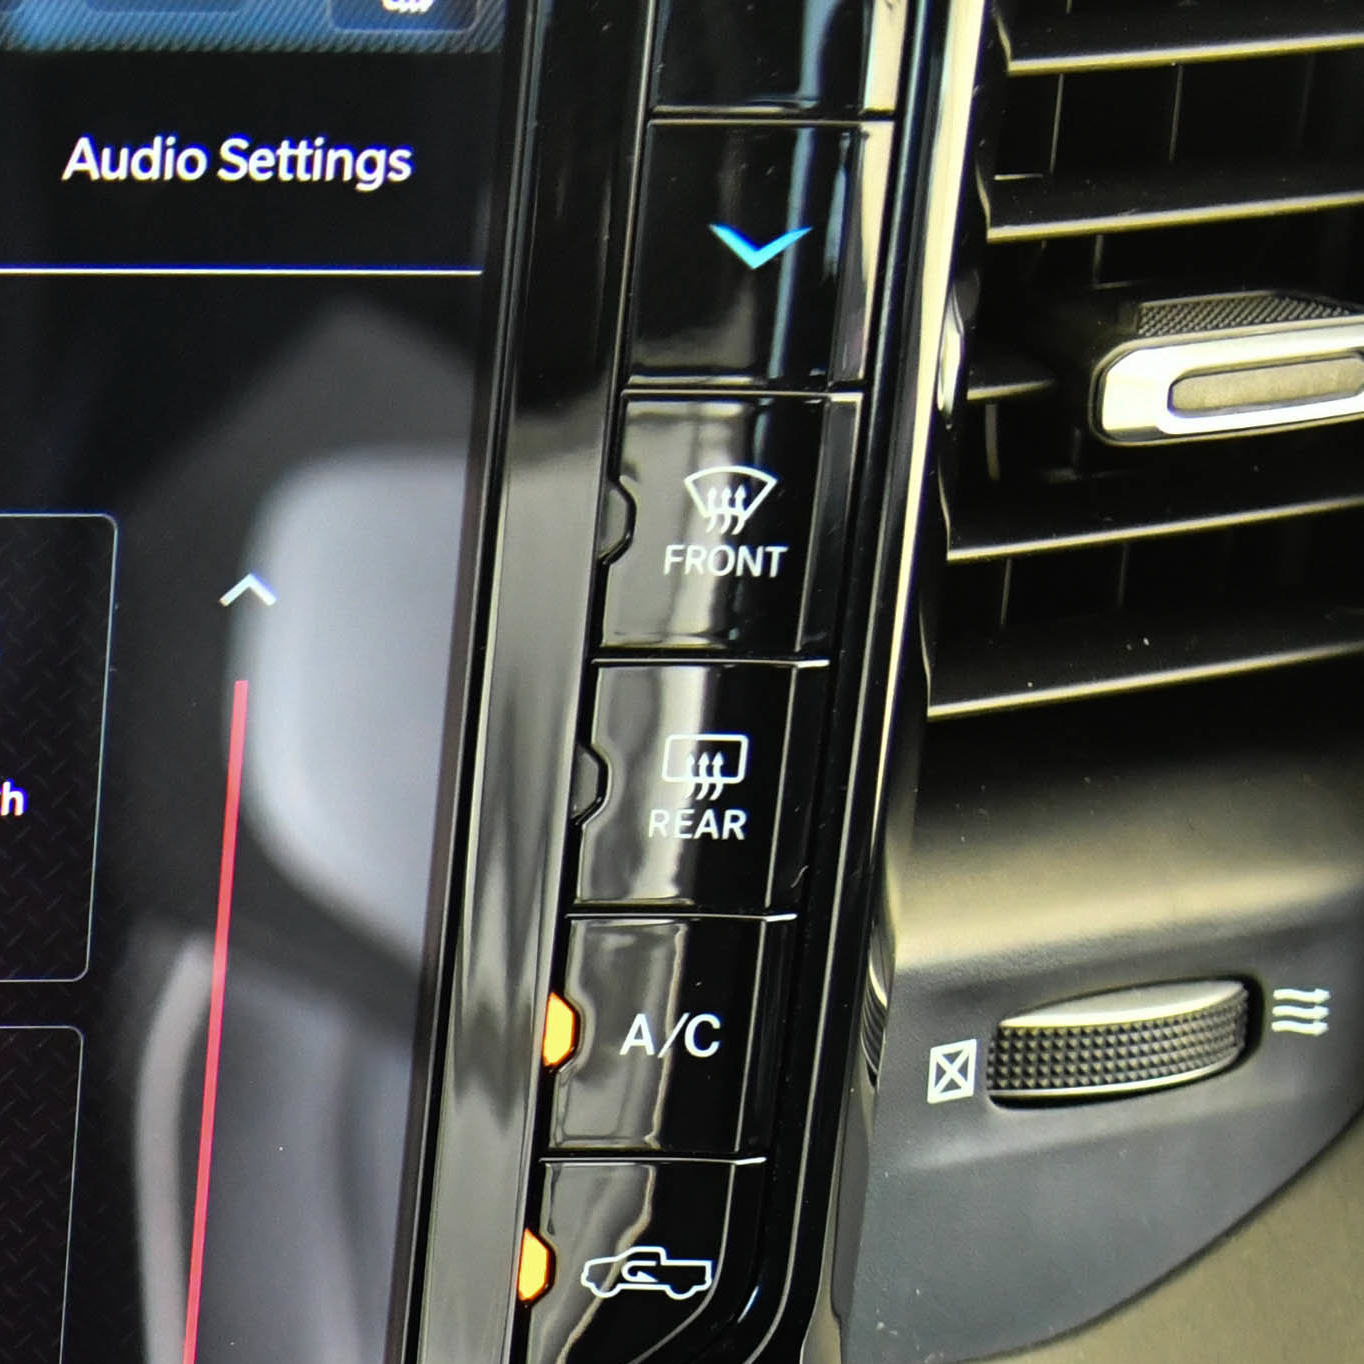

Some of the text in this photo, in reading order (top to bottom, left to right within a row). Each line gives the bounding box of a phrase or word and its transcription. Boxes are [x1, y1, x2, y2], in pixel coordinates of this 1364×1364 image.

[62, 135, 412, 192] Audio Settings
[662, 544, 788, 578] FRONT
[648, 808, 747, 840] REAR
[619, 1012, 722, 1059] A/C
